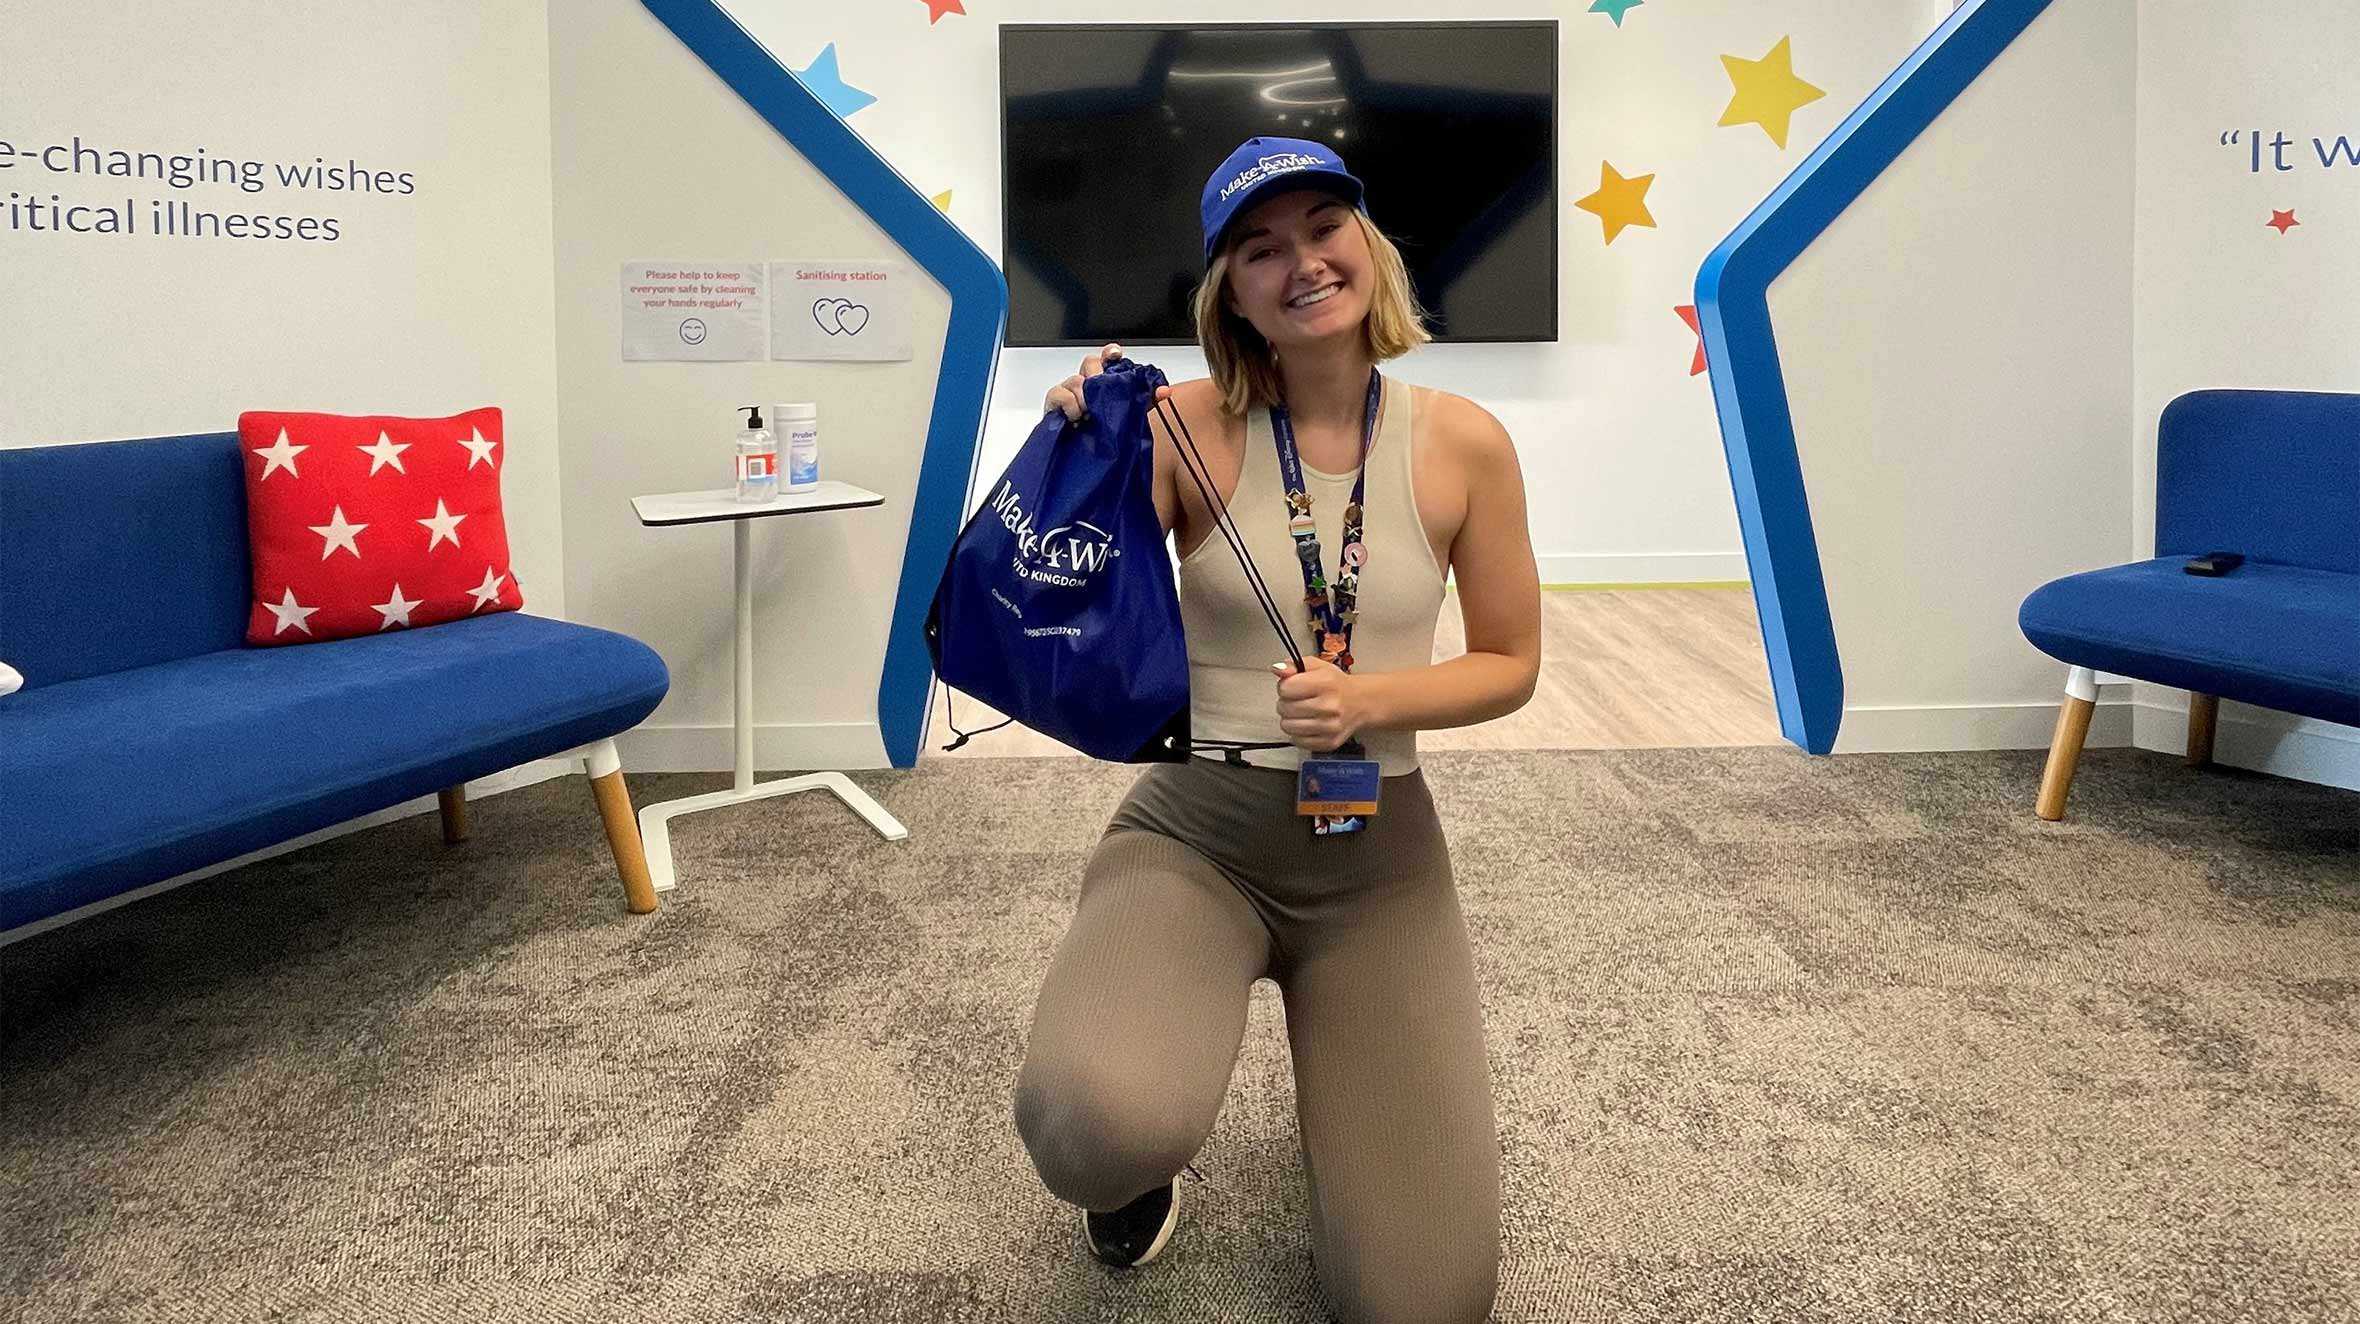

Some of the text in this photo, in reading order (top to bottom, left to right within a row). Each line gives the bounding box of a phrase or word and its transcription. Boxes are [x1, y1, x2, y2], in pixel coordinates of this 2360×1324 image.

[275, 157, 416, 195] wishes
[0, 192, 340, 242] itical illnesses
[646, 270, 741, 283] Please help to keep
[796, 270, 888, 282] Sanitising station
[630, 284, 757, 296] everyone safe by cleaning
[642, 298, 743, 310] your hands regularly
[1030, 570, 1088, 588] KINGDOM
